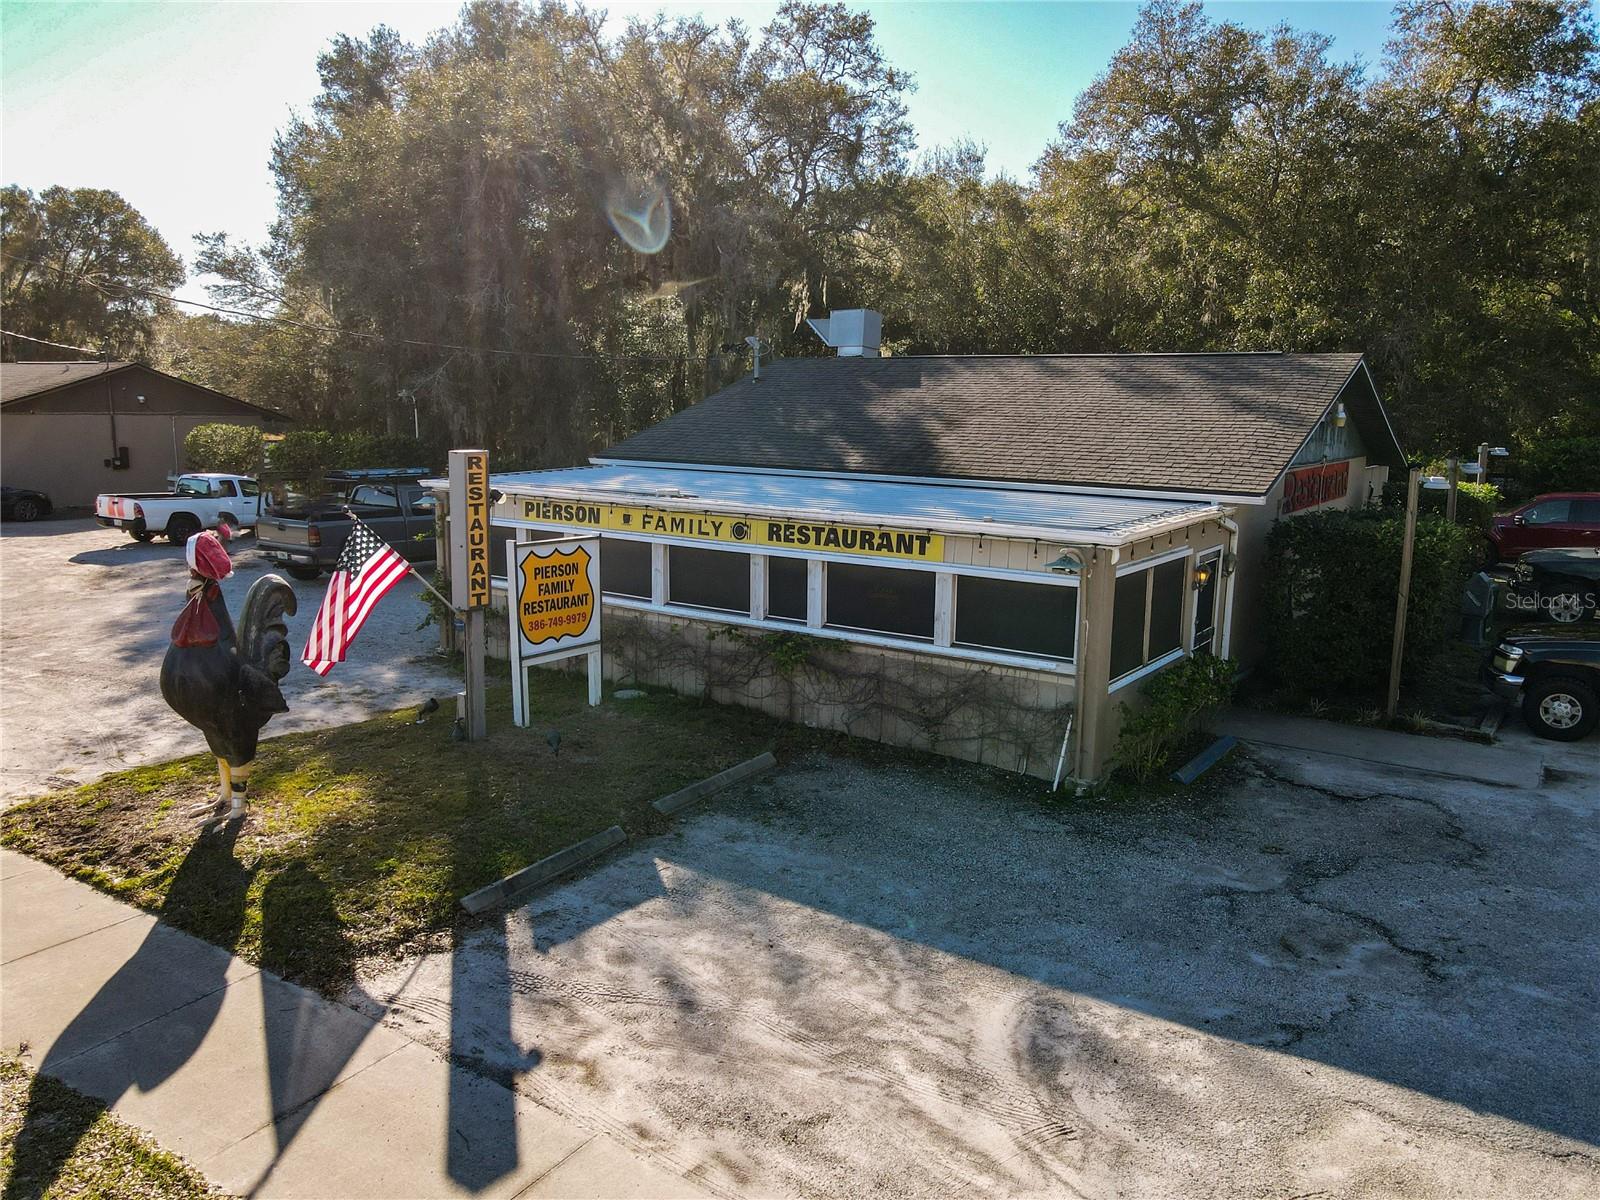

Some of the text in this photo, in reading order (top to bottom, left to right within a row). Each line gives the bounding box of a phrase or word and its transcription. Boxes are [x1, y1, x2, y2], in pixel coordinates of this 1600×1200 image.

[468, 456, 486, 606] RESTAURANT
[524, 501, 931, 556] PIERSON FAMILY RESTAURANT
[534, 562, 579, 580] PIERSON
[538, 579, 575, 597] FAMILY
[523, 593, 589, 616] RESTAURANT
[528, 612, 587, 632] 386-749-9979
